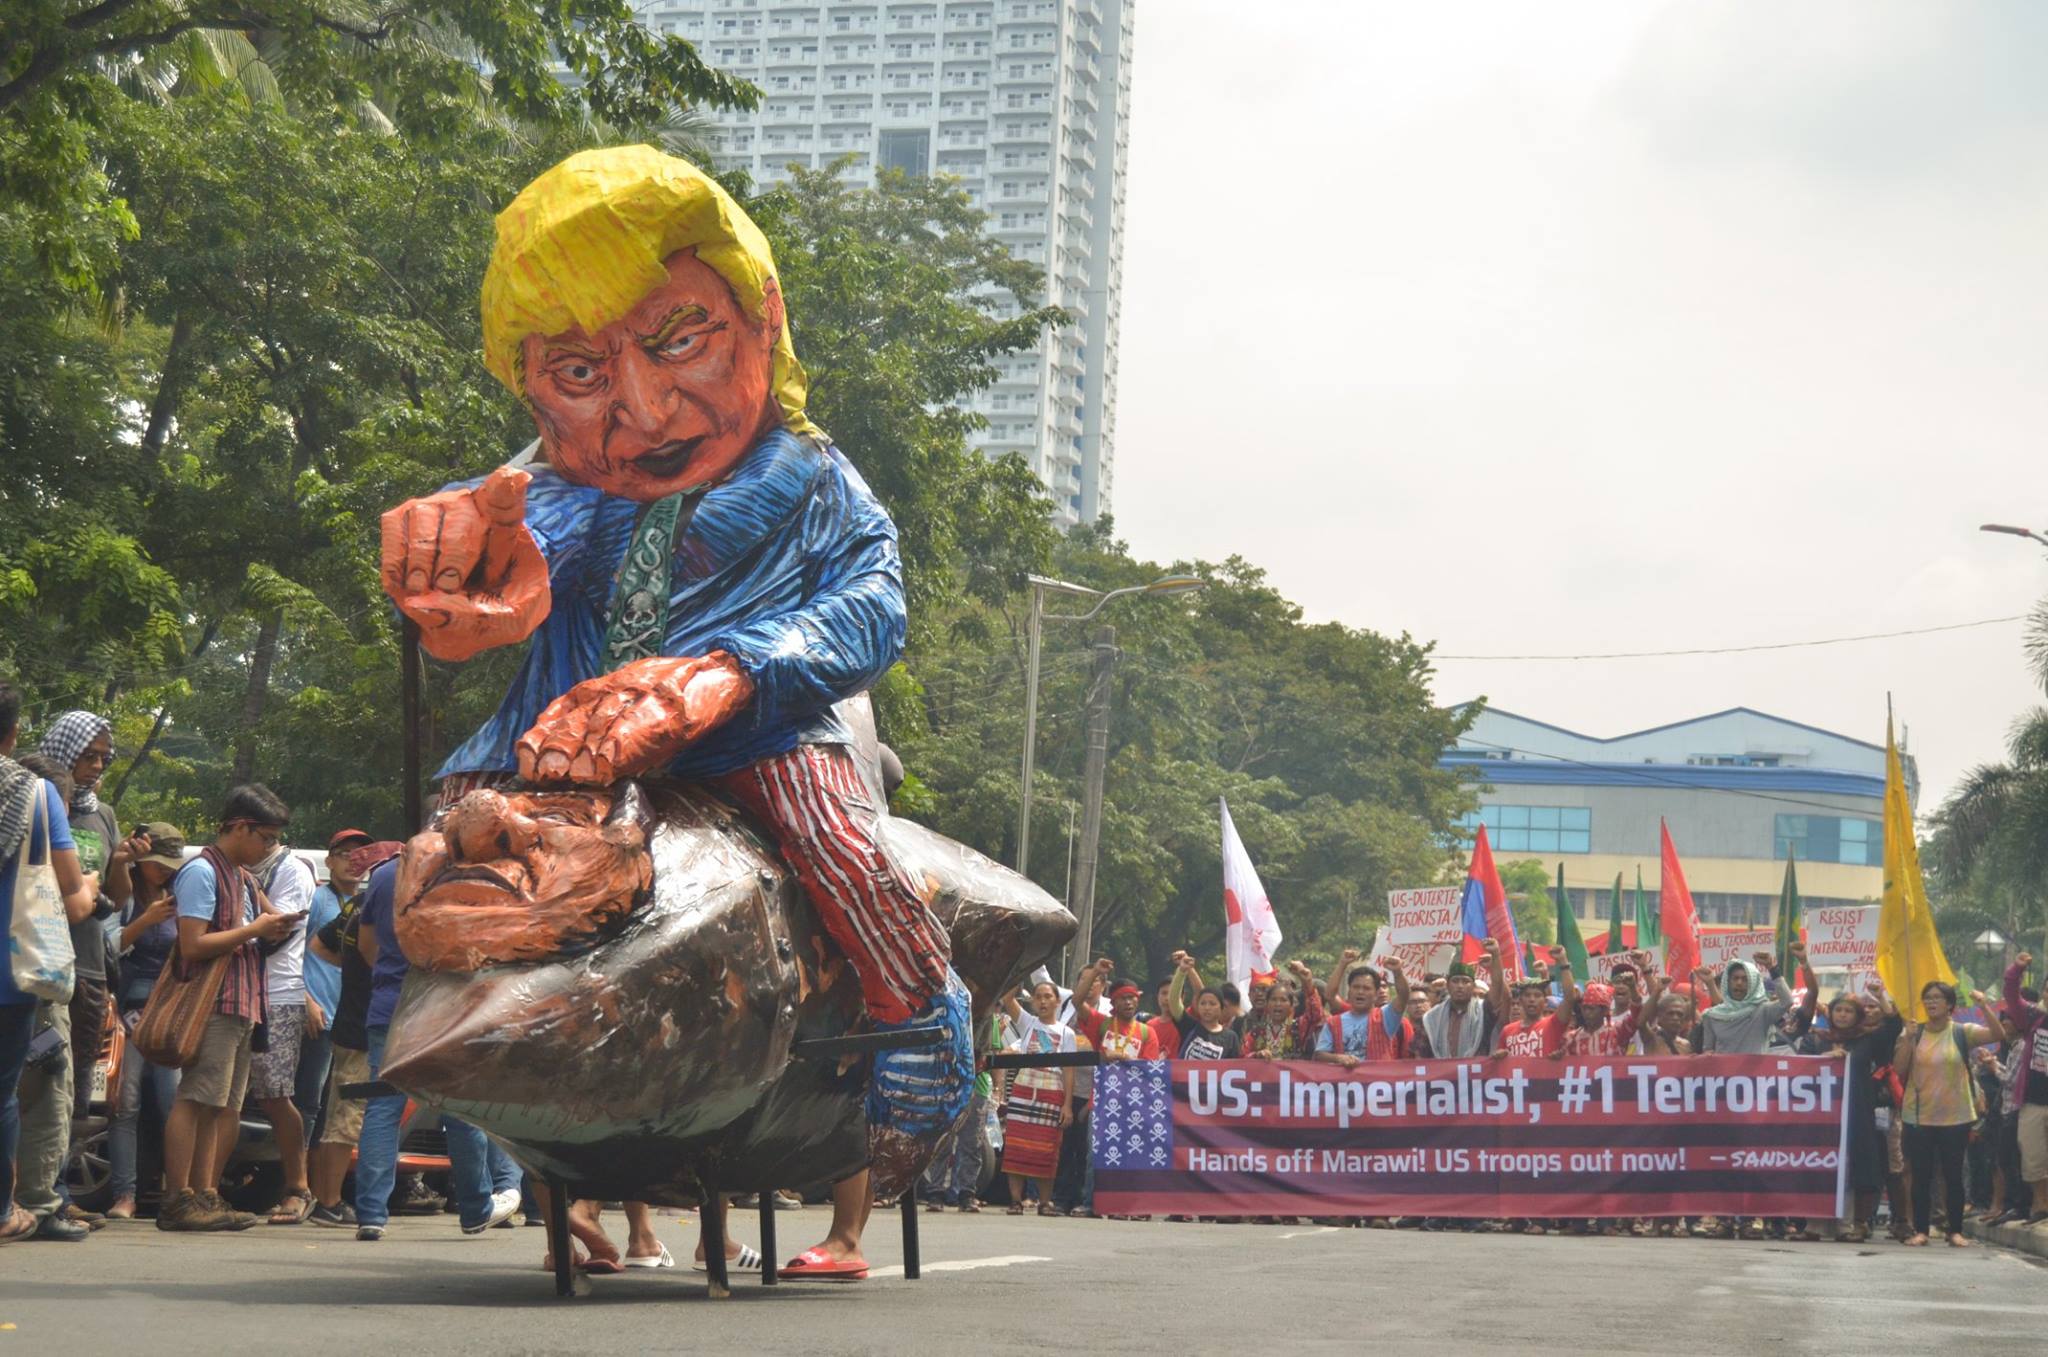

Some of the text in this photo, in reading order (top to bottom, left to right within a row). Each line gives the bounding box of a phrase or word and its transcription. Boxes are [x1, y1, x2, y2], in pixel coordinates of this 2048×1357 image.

[1392, 889, 1458, 908] US-DUTERTE
[1820, 909, 1866, 925] RESIST
[1832, 926, 1856, 939] US
[1187, 1061, 1837, 1128] US: Imperialist, #1 Terrorist
[1189, 1148, 1268, 1173] Hands
[1275, 1148, 1314, 1173] off
[1322, 1148, 1426, 1173] Marawi!
[1435, 1149, 1470, 1173] US
[1478, 1149, 1562, 1177] troops
[1570, 1148, 1613, 1173] out
[1622, 1147, 1686, 1172] now!
